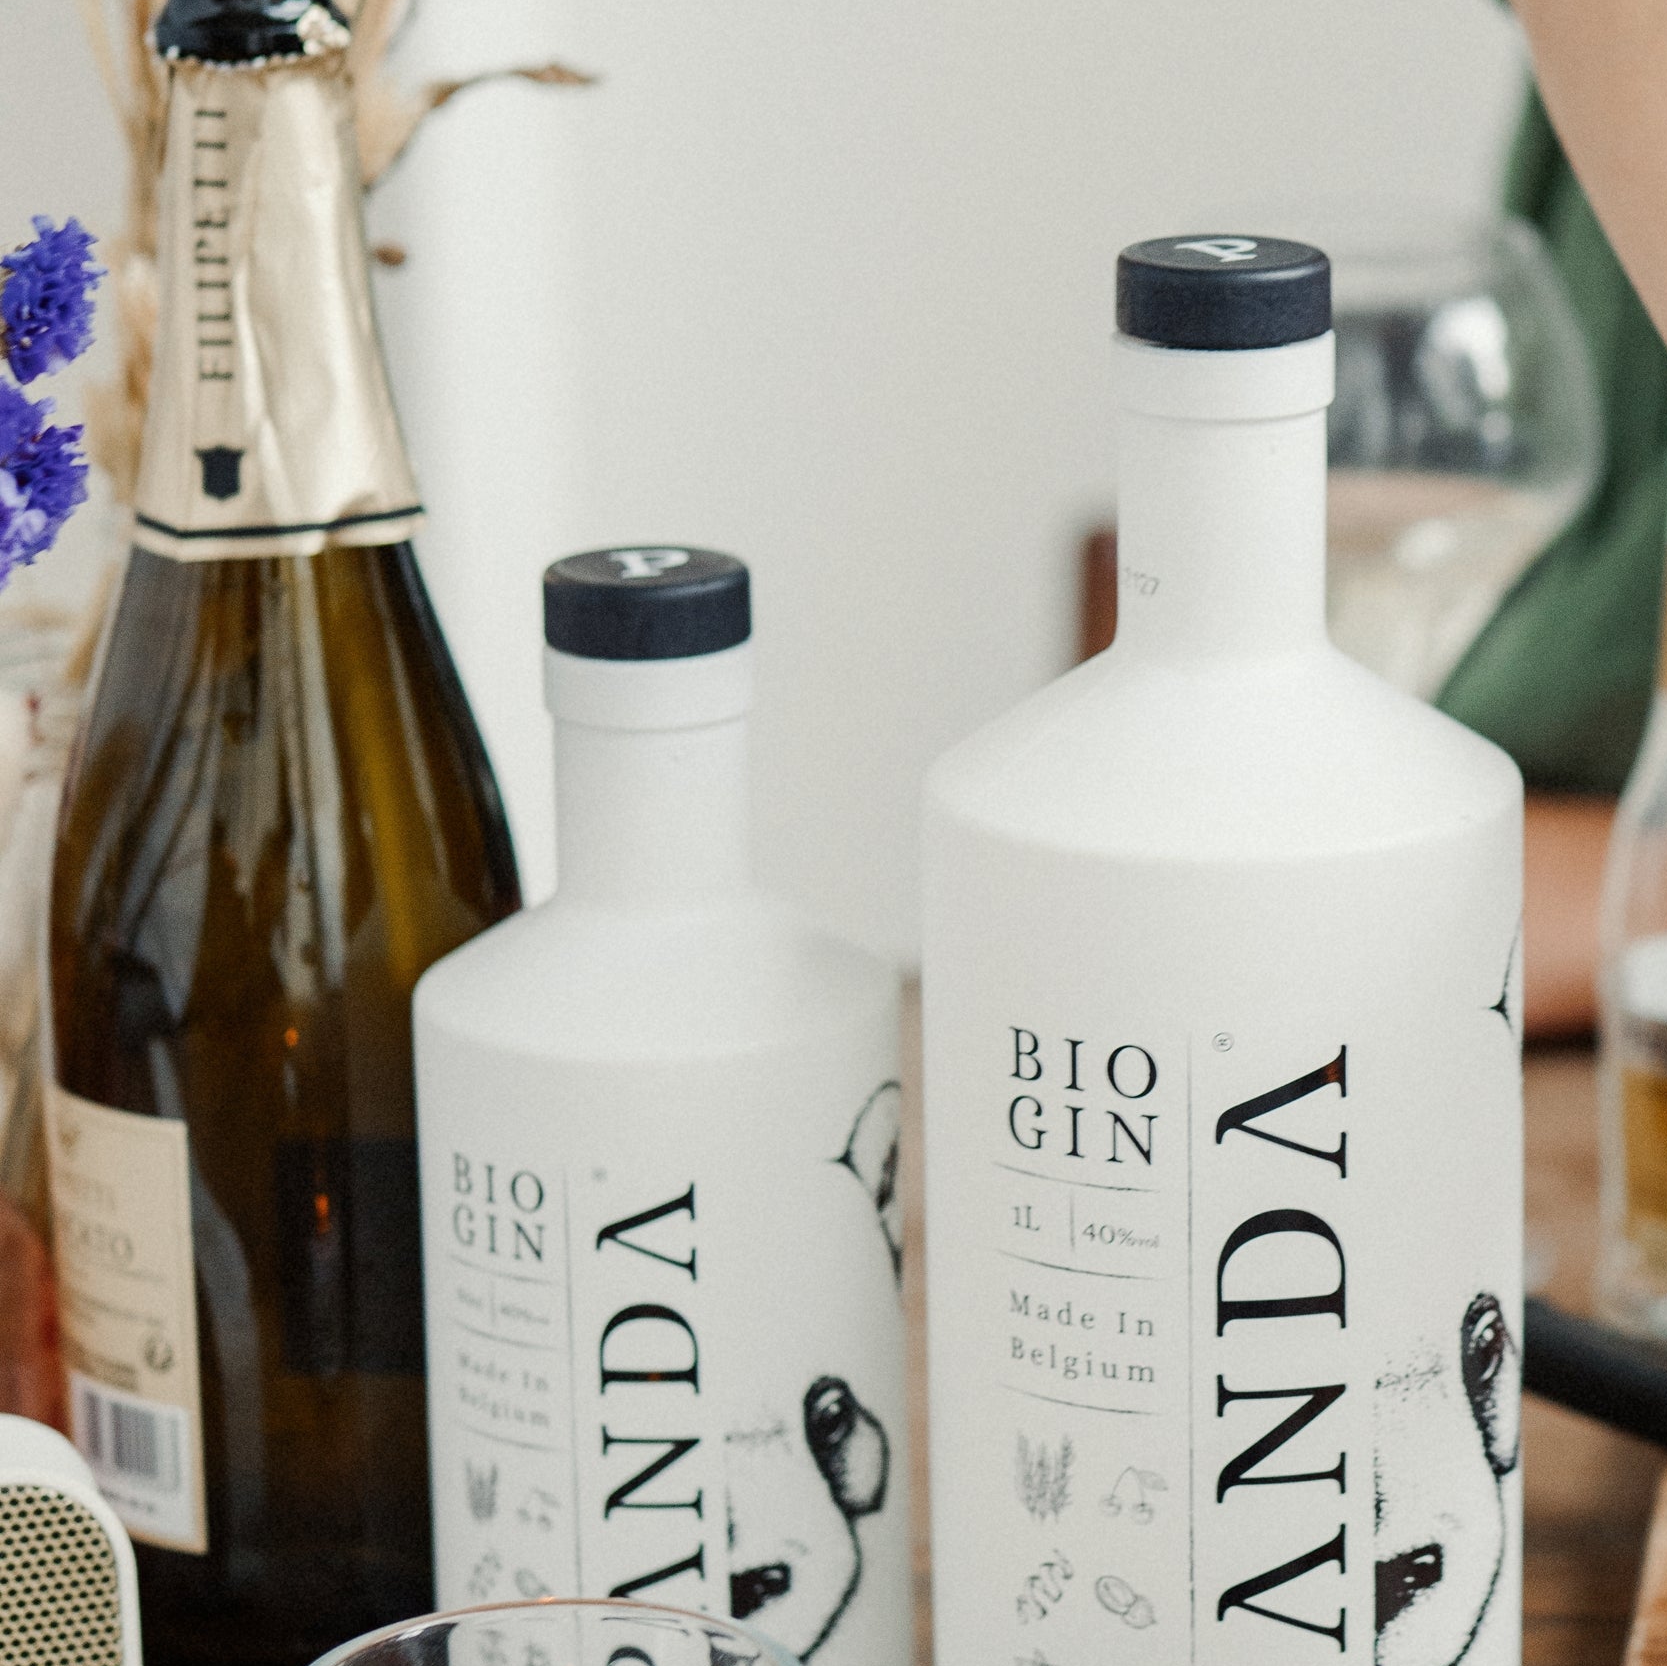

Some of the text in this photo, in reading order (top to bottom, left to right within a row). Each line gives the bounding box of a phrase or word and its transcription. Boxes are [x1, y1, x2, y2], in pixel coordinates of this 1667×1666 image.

[1009, 1026, 1157, 1099] BIO
[1009, 1095, 1160, 1165] GIN
[453, 1152, 544, 1213] BIO
[453, 1204, 544, 1261] GIN
[1012, 1205, 1041, 1232] 1L
[1010, 1290, 1155, 1336] Made In
[1010, 1336, 1155, 1383] Belgium
[1214, 1044, 1347, 1653] ANDA
